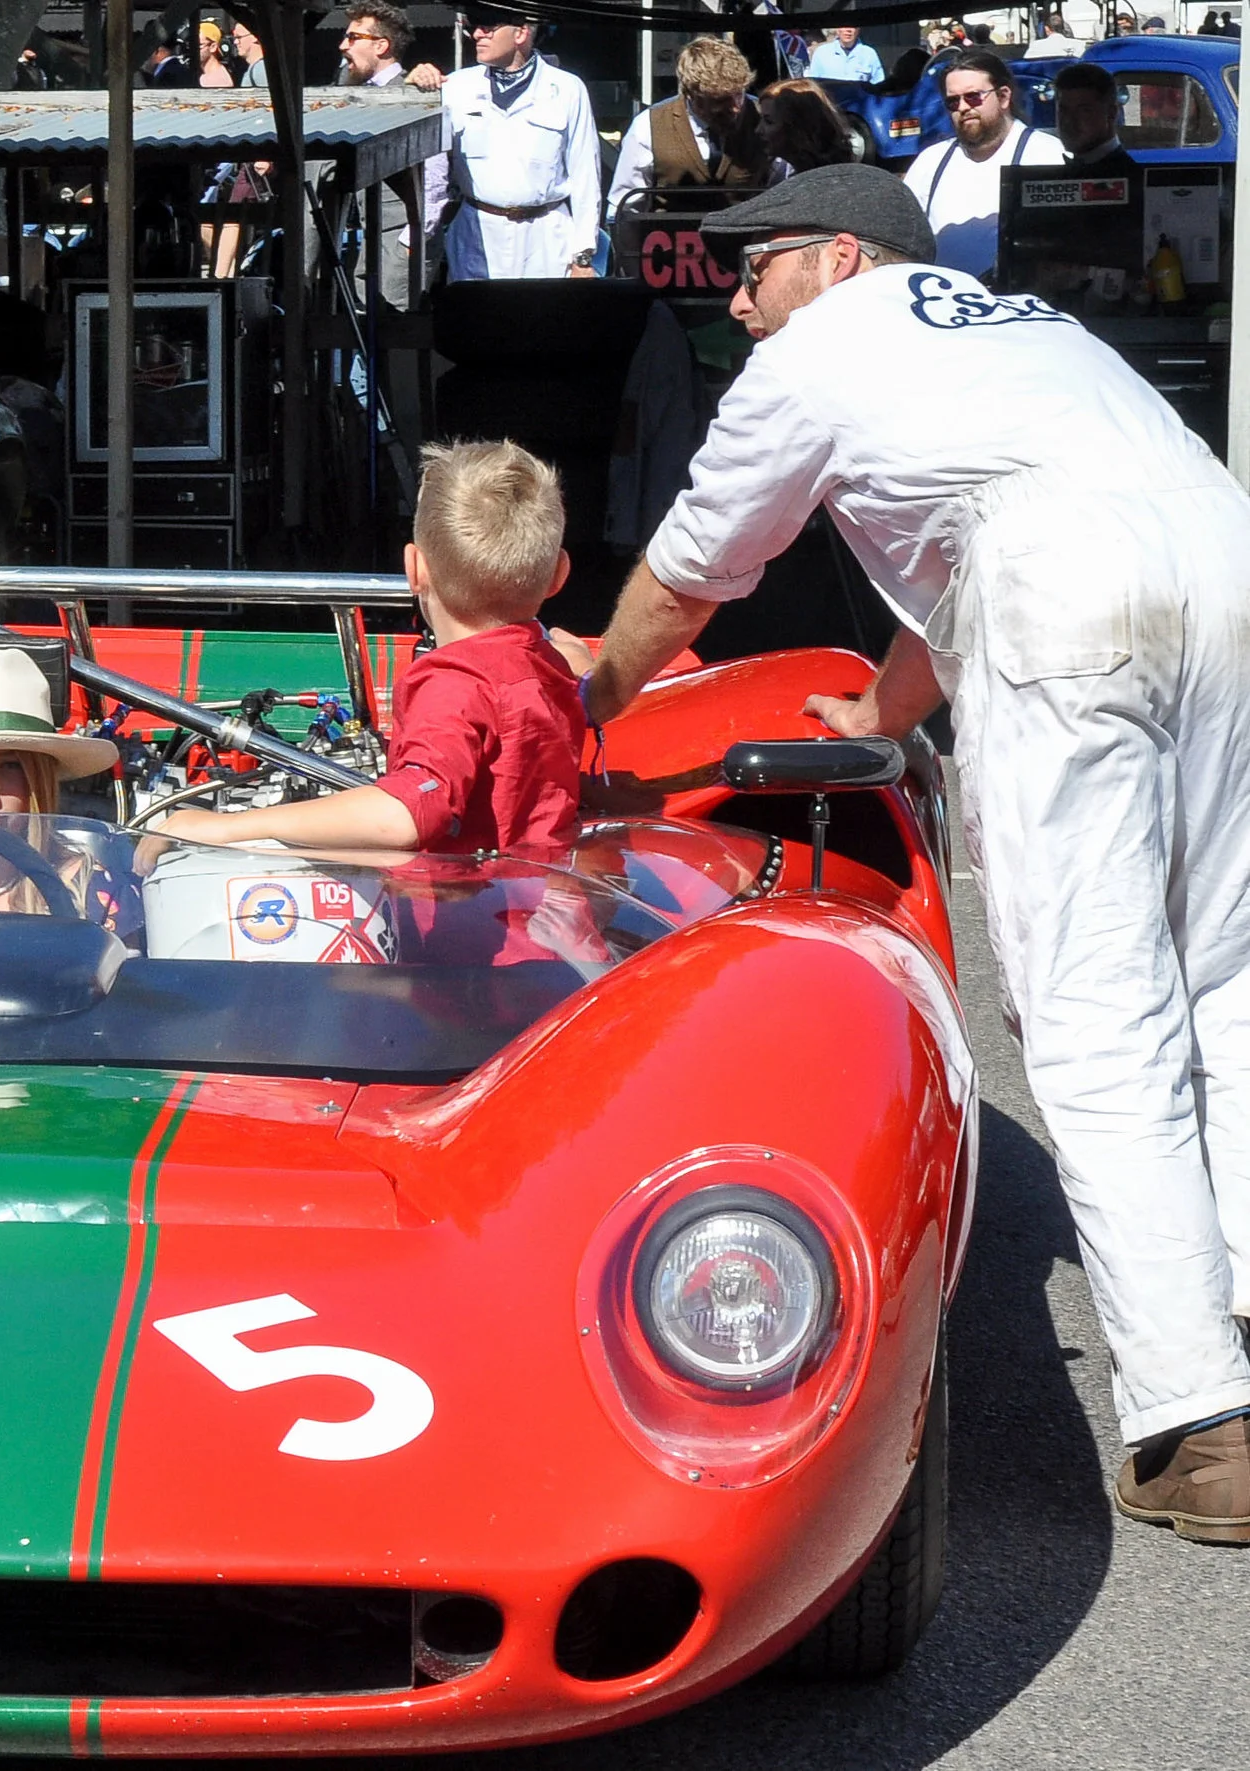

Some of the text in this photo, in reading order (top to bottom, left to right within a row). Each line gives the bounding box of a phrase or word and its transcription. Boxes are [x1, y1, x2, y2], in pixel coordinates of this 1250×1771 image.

[1025, 183, 1080, 194] THUNDER
[1029, 193, 1076, 204] SPORTS
[315, 883, 350, 905] 105
[152, 1293, 435, 1462] 5
